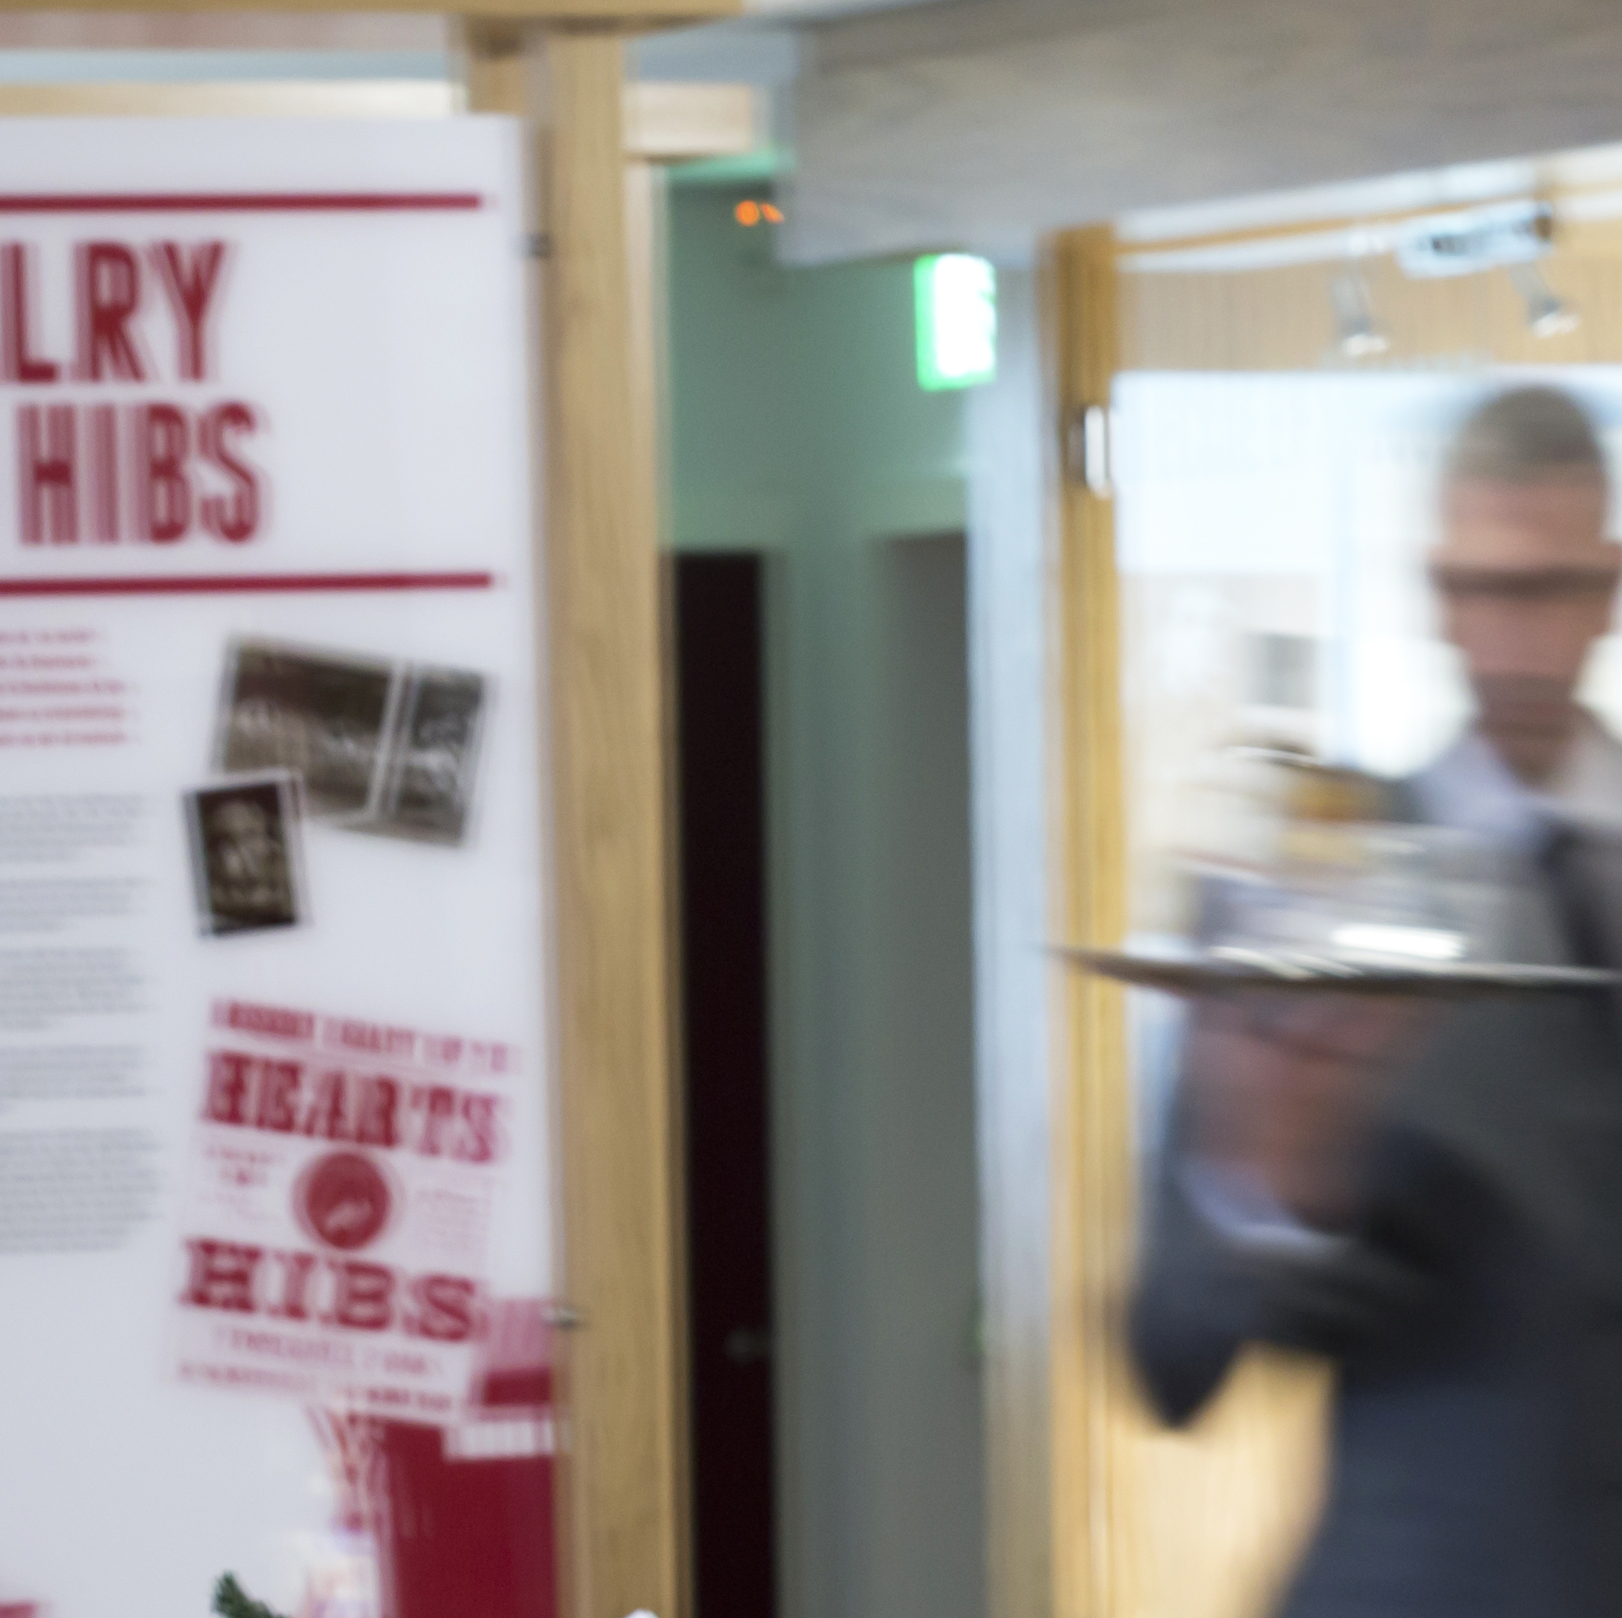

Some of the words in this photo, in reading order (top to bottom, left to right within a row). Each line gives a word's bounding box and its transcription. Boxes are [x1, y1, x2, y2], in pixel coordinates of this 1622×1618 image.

[17, 402, 265, 546] HIBS
[202, 1050, 504, 1164] HEARTS
[181, 1236, 485, 1343] HIBS
